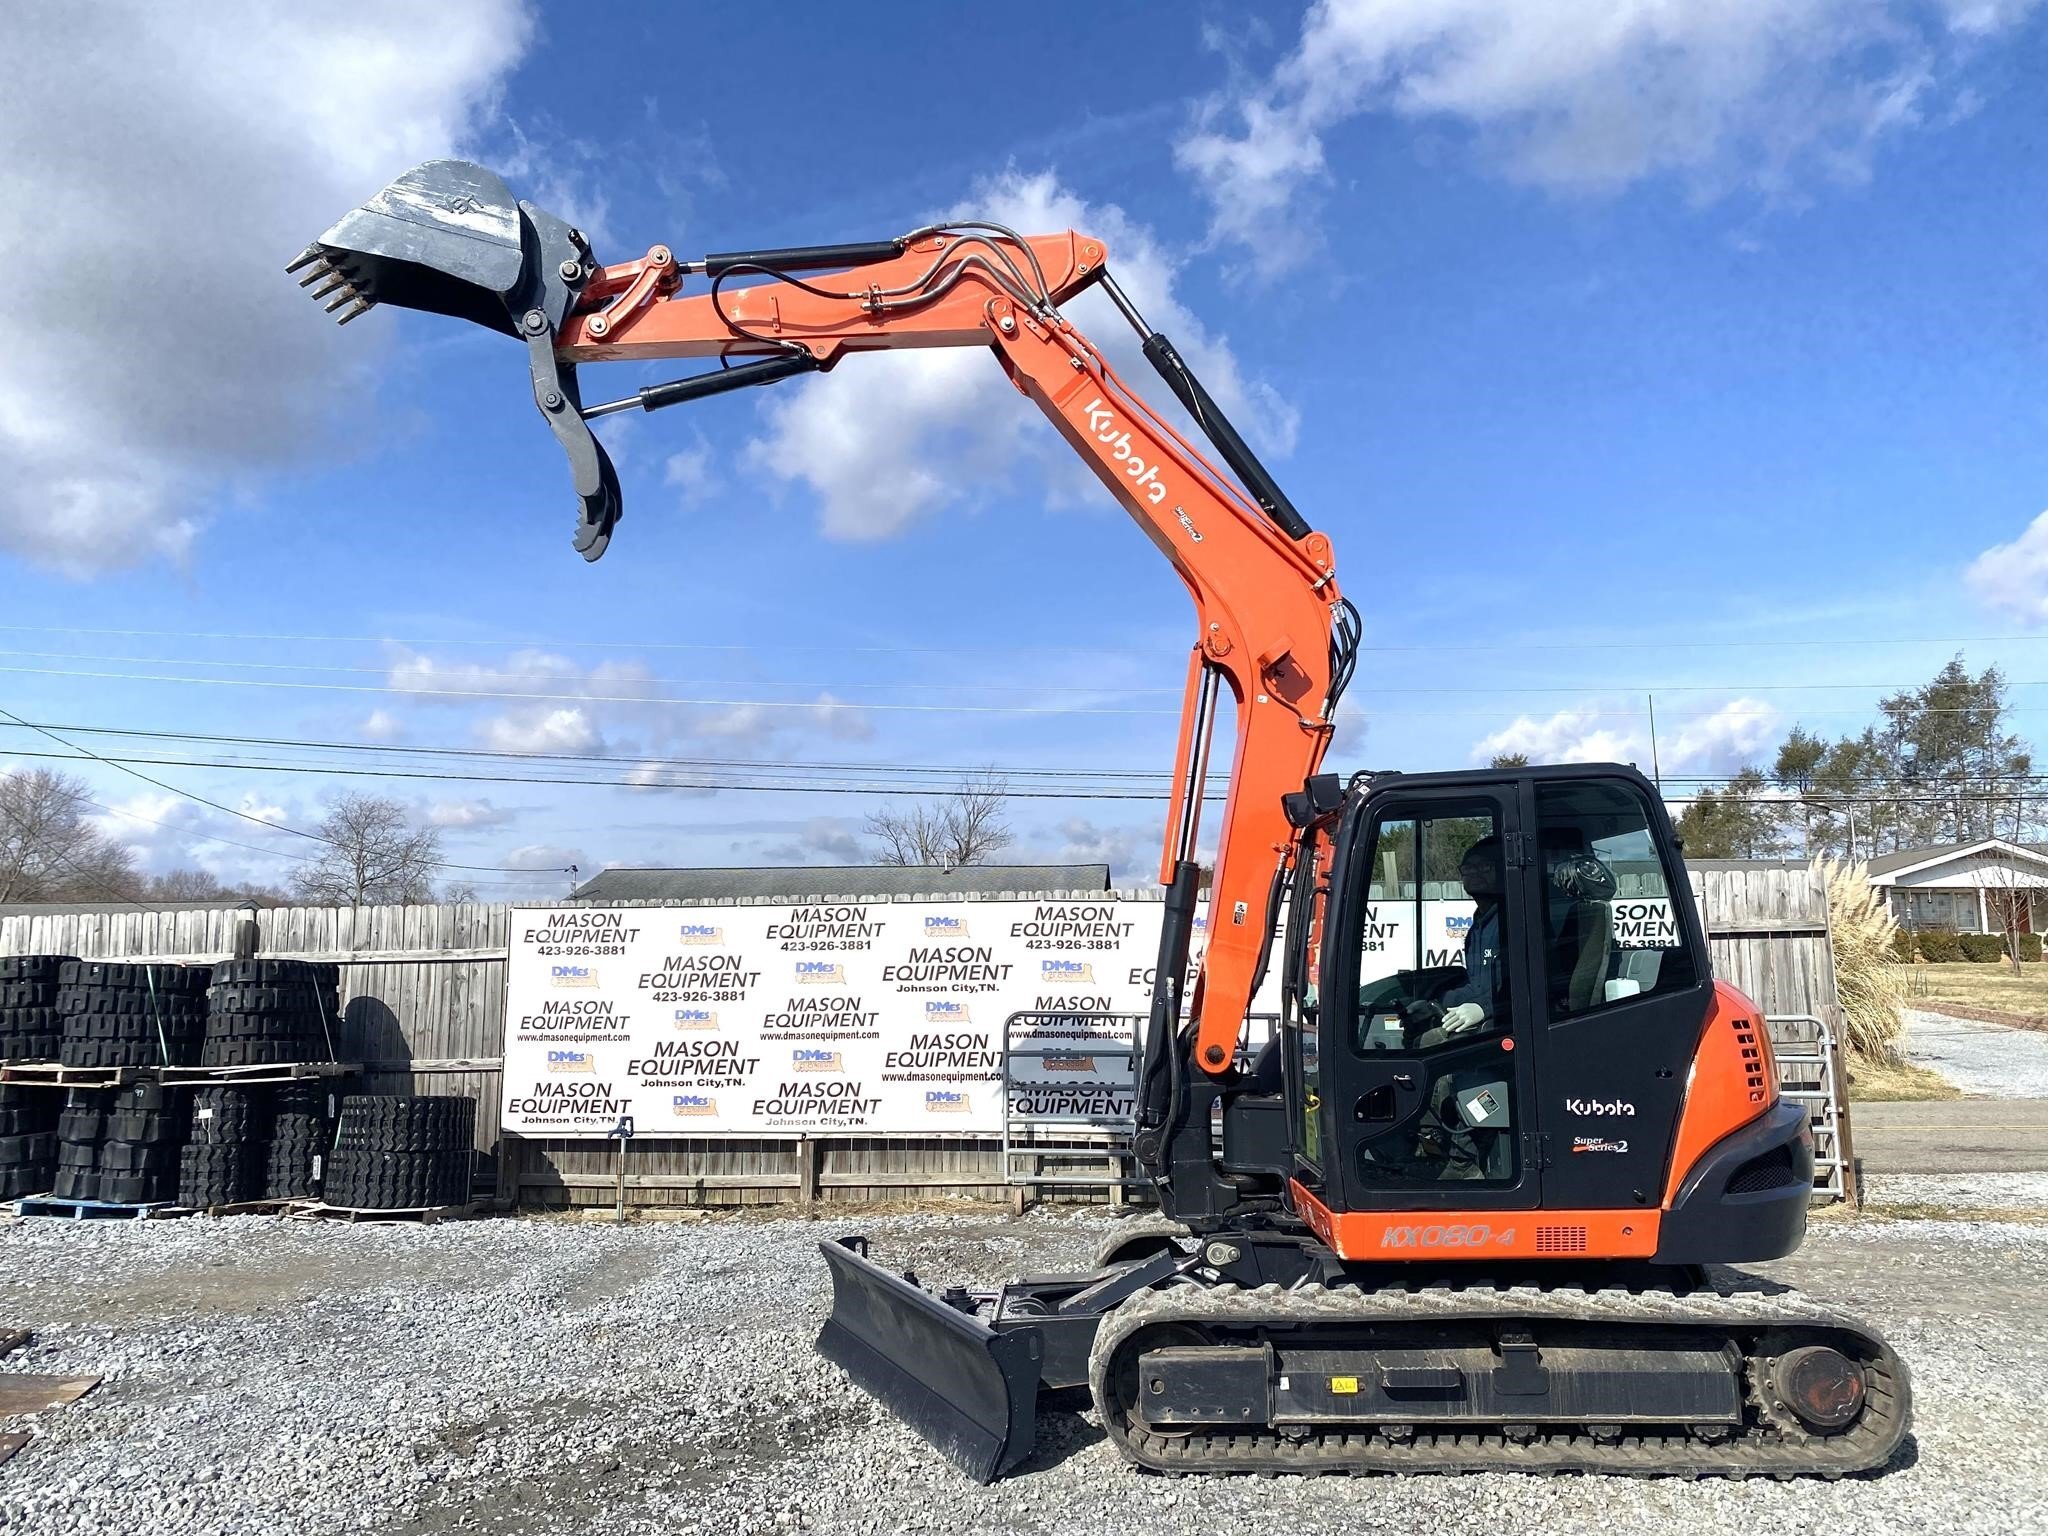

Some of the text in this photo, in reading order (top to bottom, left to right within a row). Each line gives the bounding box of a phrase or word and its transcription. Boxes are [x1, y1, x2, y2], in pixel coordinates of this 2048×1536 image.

[1084, 398, 1167, 504] Kubota
[791, 908, 866, 922] MASON
[1035, 907, 1114, 921] MASON
[1614, 905, 1666, 920] SON
[548, 914, 622, 927] MASON
[524, 929, 640, 943] EQUIPMENT
[767, 923, 885, 939] EQUIPMENT
[1011, 923, 1134, 937] EQUIPMENT
[538, 946, 624, 955] 423-926-3881
[781, 941, 870, 951] 423-926-3881
[1026, 940, 1119, 949] 423-926-3881
[909, 947, 992, 963] MASON
[664, 956, 741, 971] MASON
[883, 965, 1013, 981] EQUIPMENT
[639, 973, 760, 988] EQUIPMENT
[653, 991, 744, 1001] 423-926-3881
[543, 1001, 613, 1014] MASON
[787, 998, 861, 1011] MASON
[1035, 997, 1111, 1010] MASON
[521, 1016, 630, 1029] EQUIPMENT
[764, 1013, 879, 1028] EQUIPMENT
[518, 1033, 630, 1043] www.dmasonequipment.com
[760, 1031, 879, 1041] www.dmasonequipment.com
[910, 1034, 988, 1049] MASON
[1009, 1030, 1133, 1041] www.dmasonequipment.com
[654, 1041, 739, 1057] MASON
[628, 1059, 760, 1075] EQUIPMENT
[534, 1083, 612, 1097] MASON
[641, 1079, 692, 1087] Johnson
[779, 1082, 861, 1097] MASON
[509, 1099, 632, 1113] EQUIPMENT
[752, 1099, 882, 1114] EQUIPMENT
[1566, 1099, 1635, 1115] Kubota
[1573, 1136, 1603, 1145] Super
[1380, 1225, 1516, 1248] KX080-4
